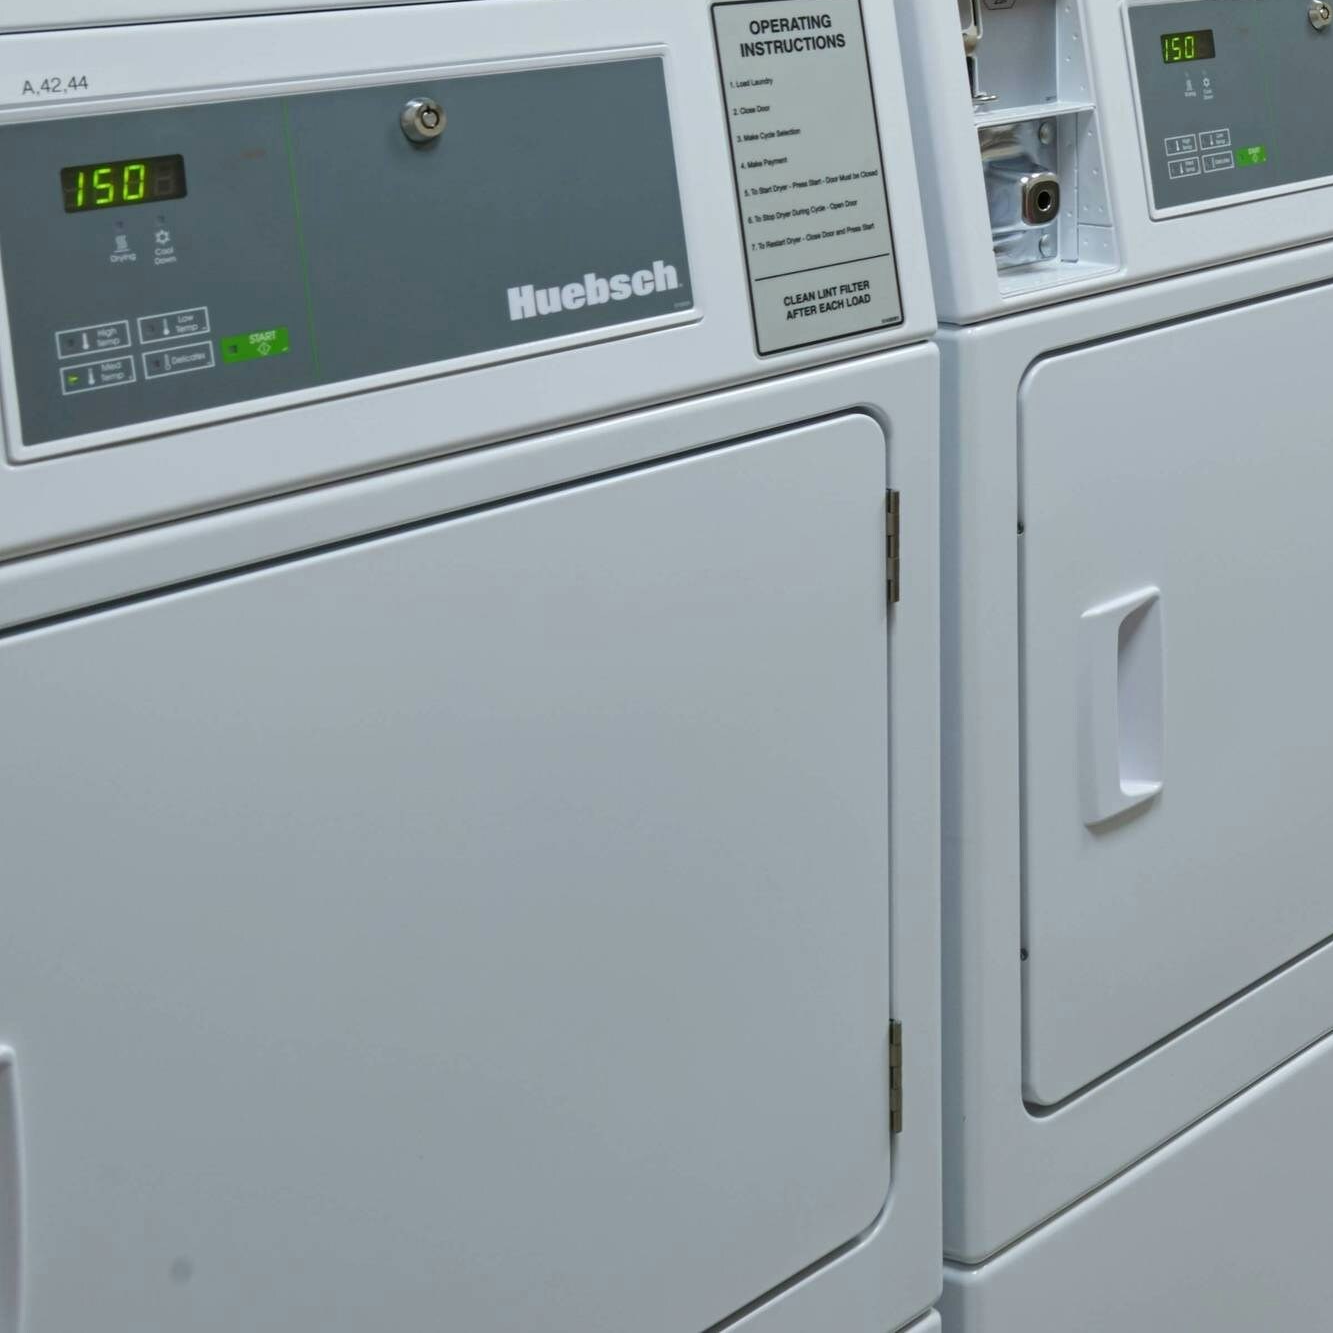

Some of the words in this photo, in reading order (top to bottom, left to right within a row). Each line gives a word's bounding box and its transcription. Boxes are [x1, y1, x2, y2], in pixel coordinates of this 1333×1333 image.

[749, 14, 831, 35] OPERATING
[740, 34, 846, 57] INSTRUCTIONS
[1165, 36, 1194, 61] 150
[750, 77, 773, 86] Laundry
[757, 105, 770, 113] Door
[776, 128, 800, 137] Selection
[763, 157, 787, 166] Payment
[77, 164, 145, 207] 150
[507, 260, 678, 321] Huebsch
[784, 291, 815, 307] CLEAN
[817, 287, 837, 300] LINT
[840, 280, 870, 295] FILTER
[787, 306, 817, 320] AFTER
[820, 299, 844, 314] EACH
[846, 294, 871, 308] LOAD
[249, 331, 275, 343] START
